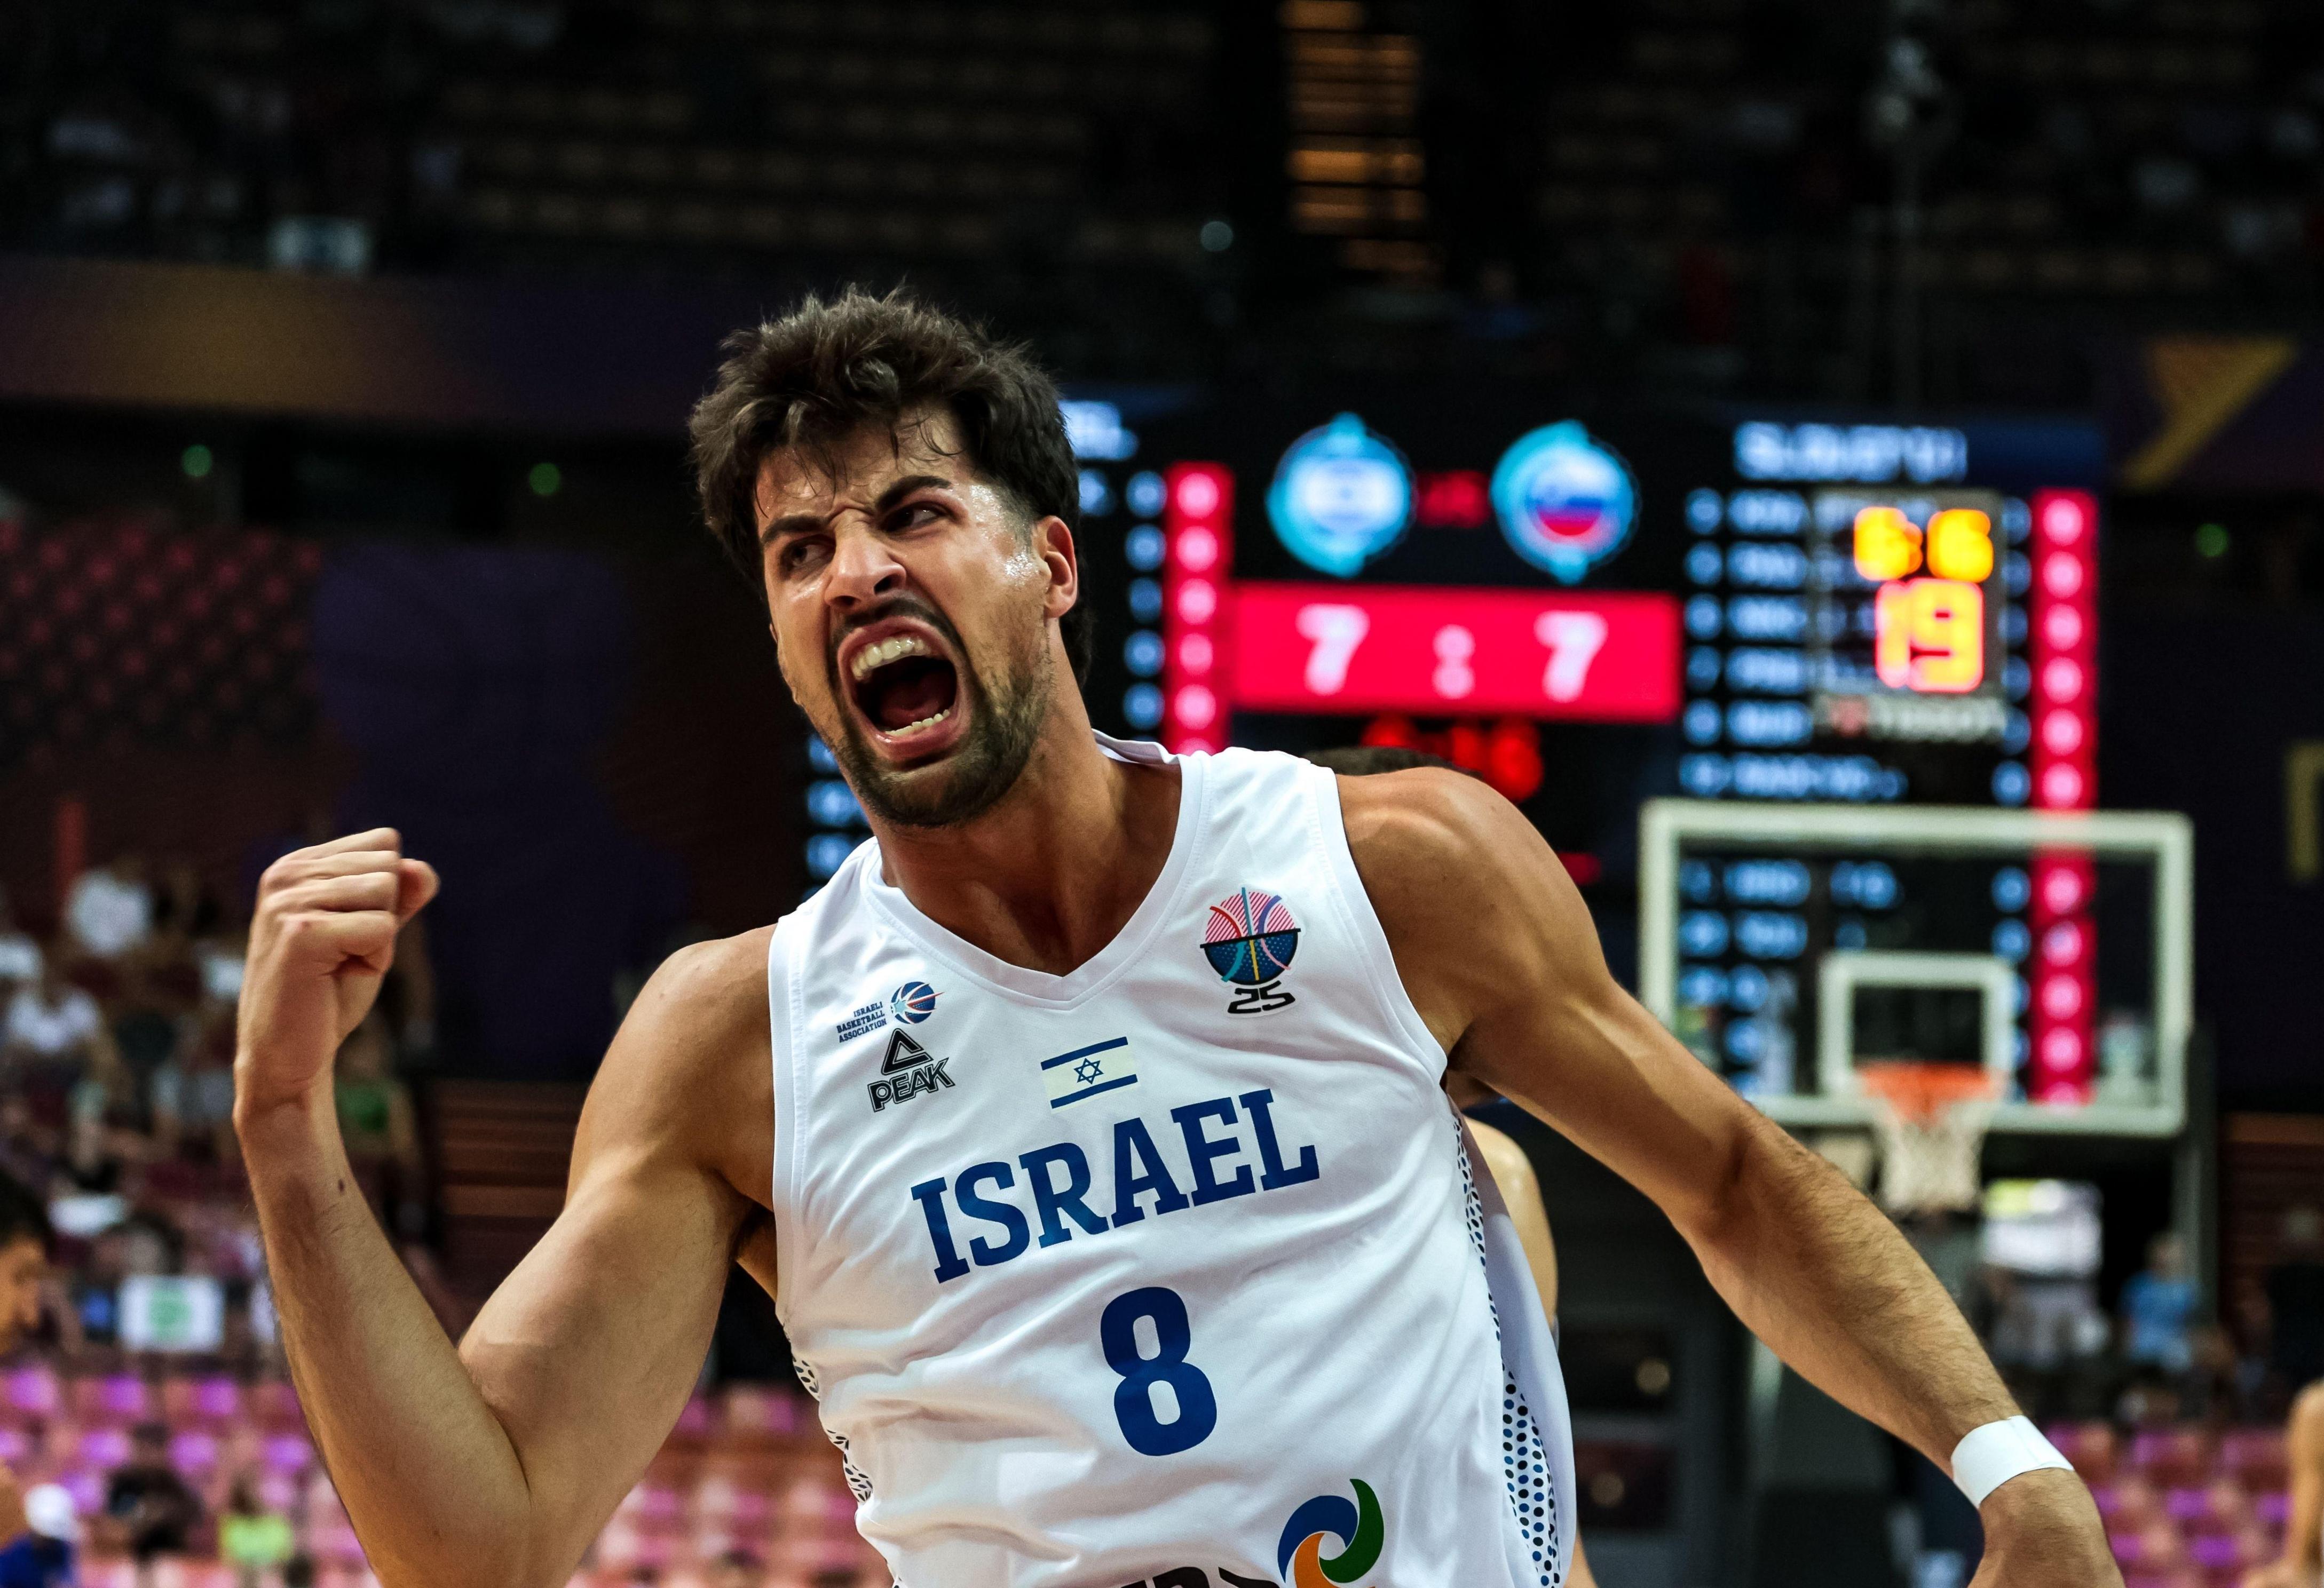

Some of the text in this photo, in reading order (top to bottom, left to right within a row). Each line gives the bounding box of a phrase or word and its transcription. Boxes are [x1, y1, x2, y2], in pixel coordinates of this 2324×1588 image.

[1296, 603, 1370, 695] 7
[1533, 609, 1609, 703] 7
[1875, 577, 1985, 692] 19
[836, 1010, 886, 1034] BASKETBALL
[853, 1002, 883, 1017] ISRAELI
[1227, 980, 1296, 1014] 25
[839, 1018, 887, 1043] ASSOCIATION
[867, 1057, 956, 1113] PEAK
[910, 1088, 1320, 1284] ISRAEL
[1100, 1287, 1218, 1456] 8
